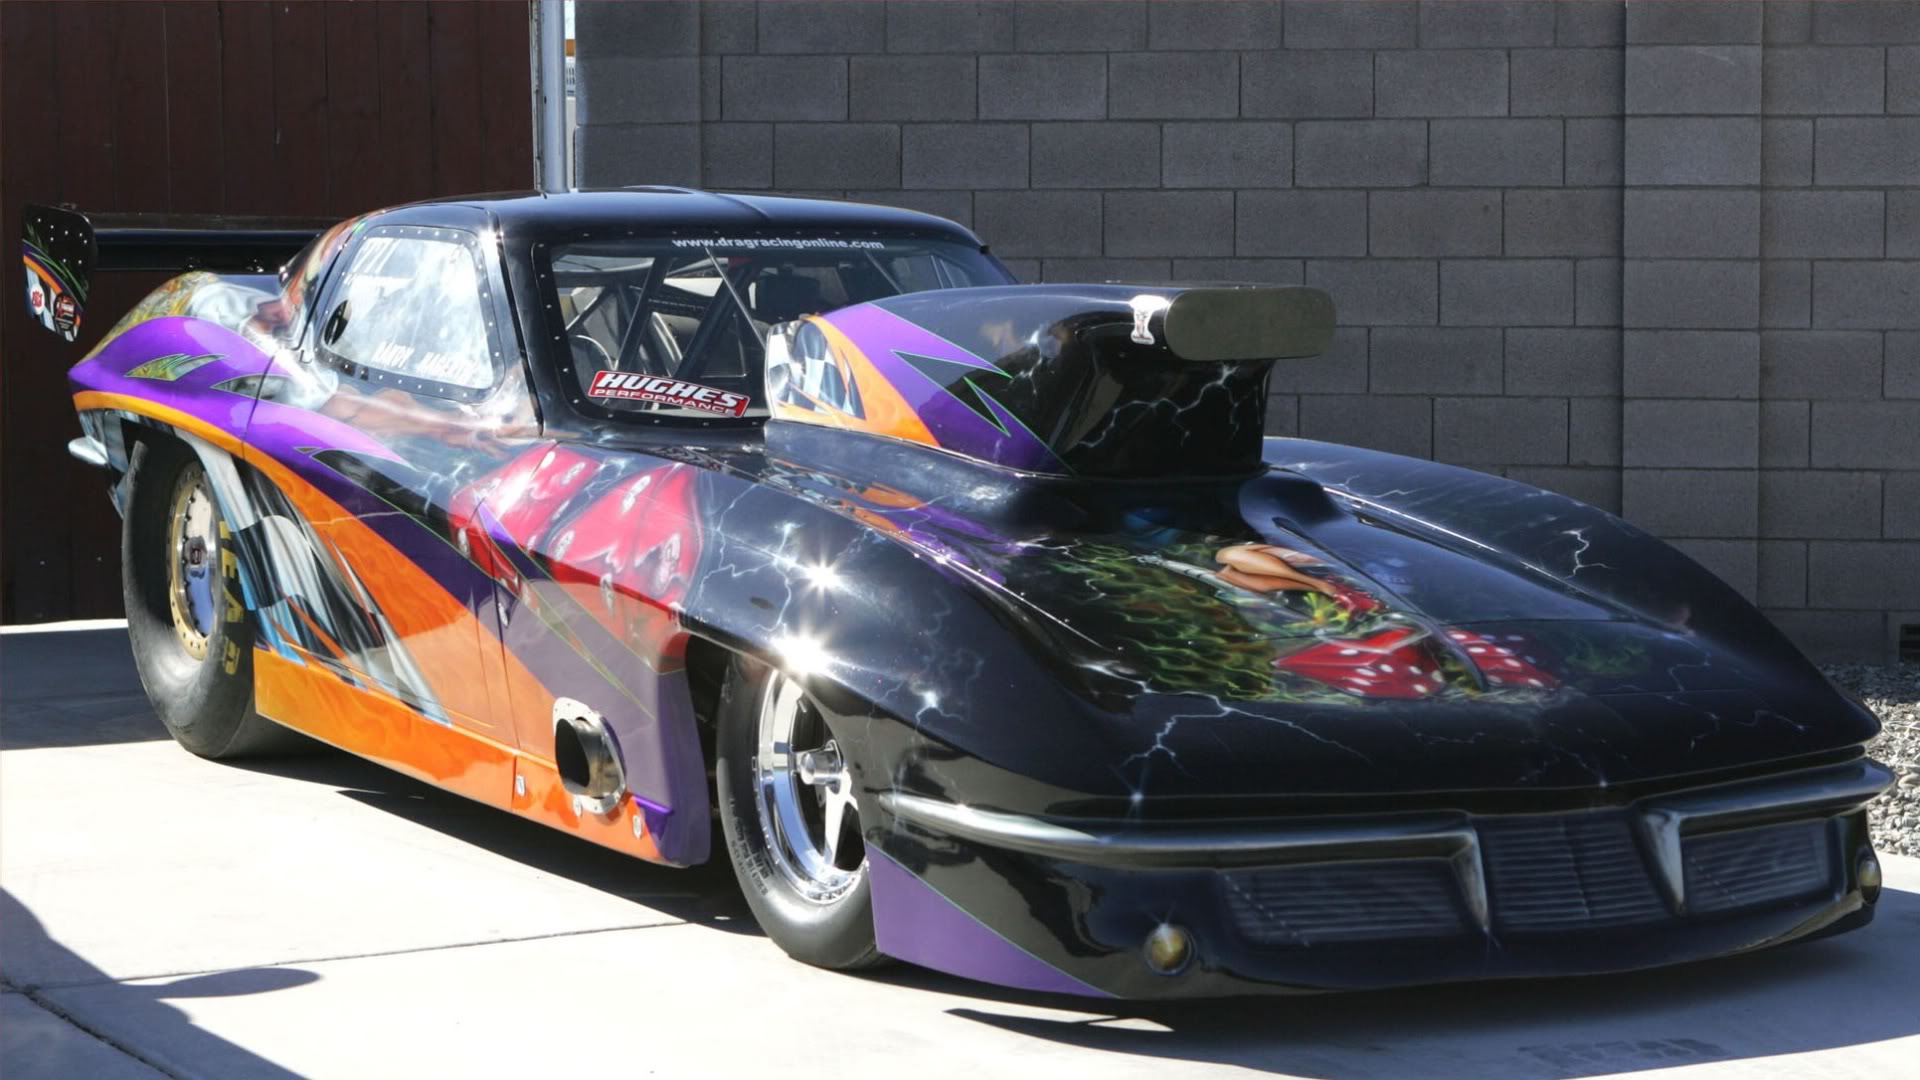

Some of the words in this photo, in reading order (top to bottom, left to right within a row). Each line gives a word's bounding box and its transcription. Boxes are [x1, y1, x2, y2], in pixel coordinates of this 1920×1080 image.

[672, 237, 885, 249] www.dragracingonline.com
[594, 389, 737, 418] PERFORMANCE
[596, 373, 745, 408] HUGHES
